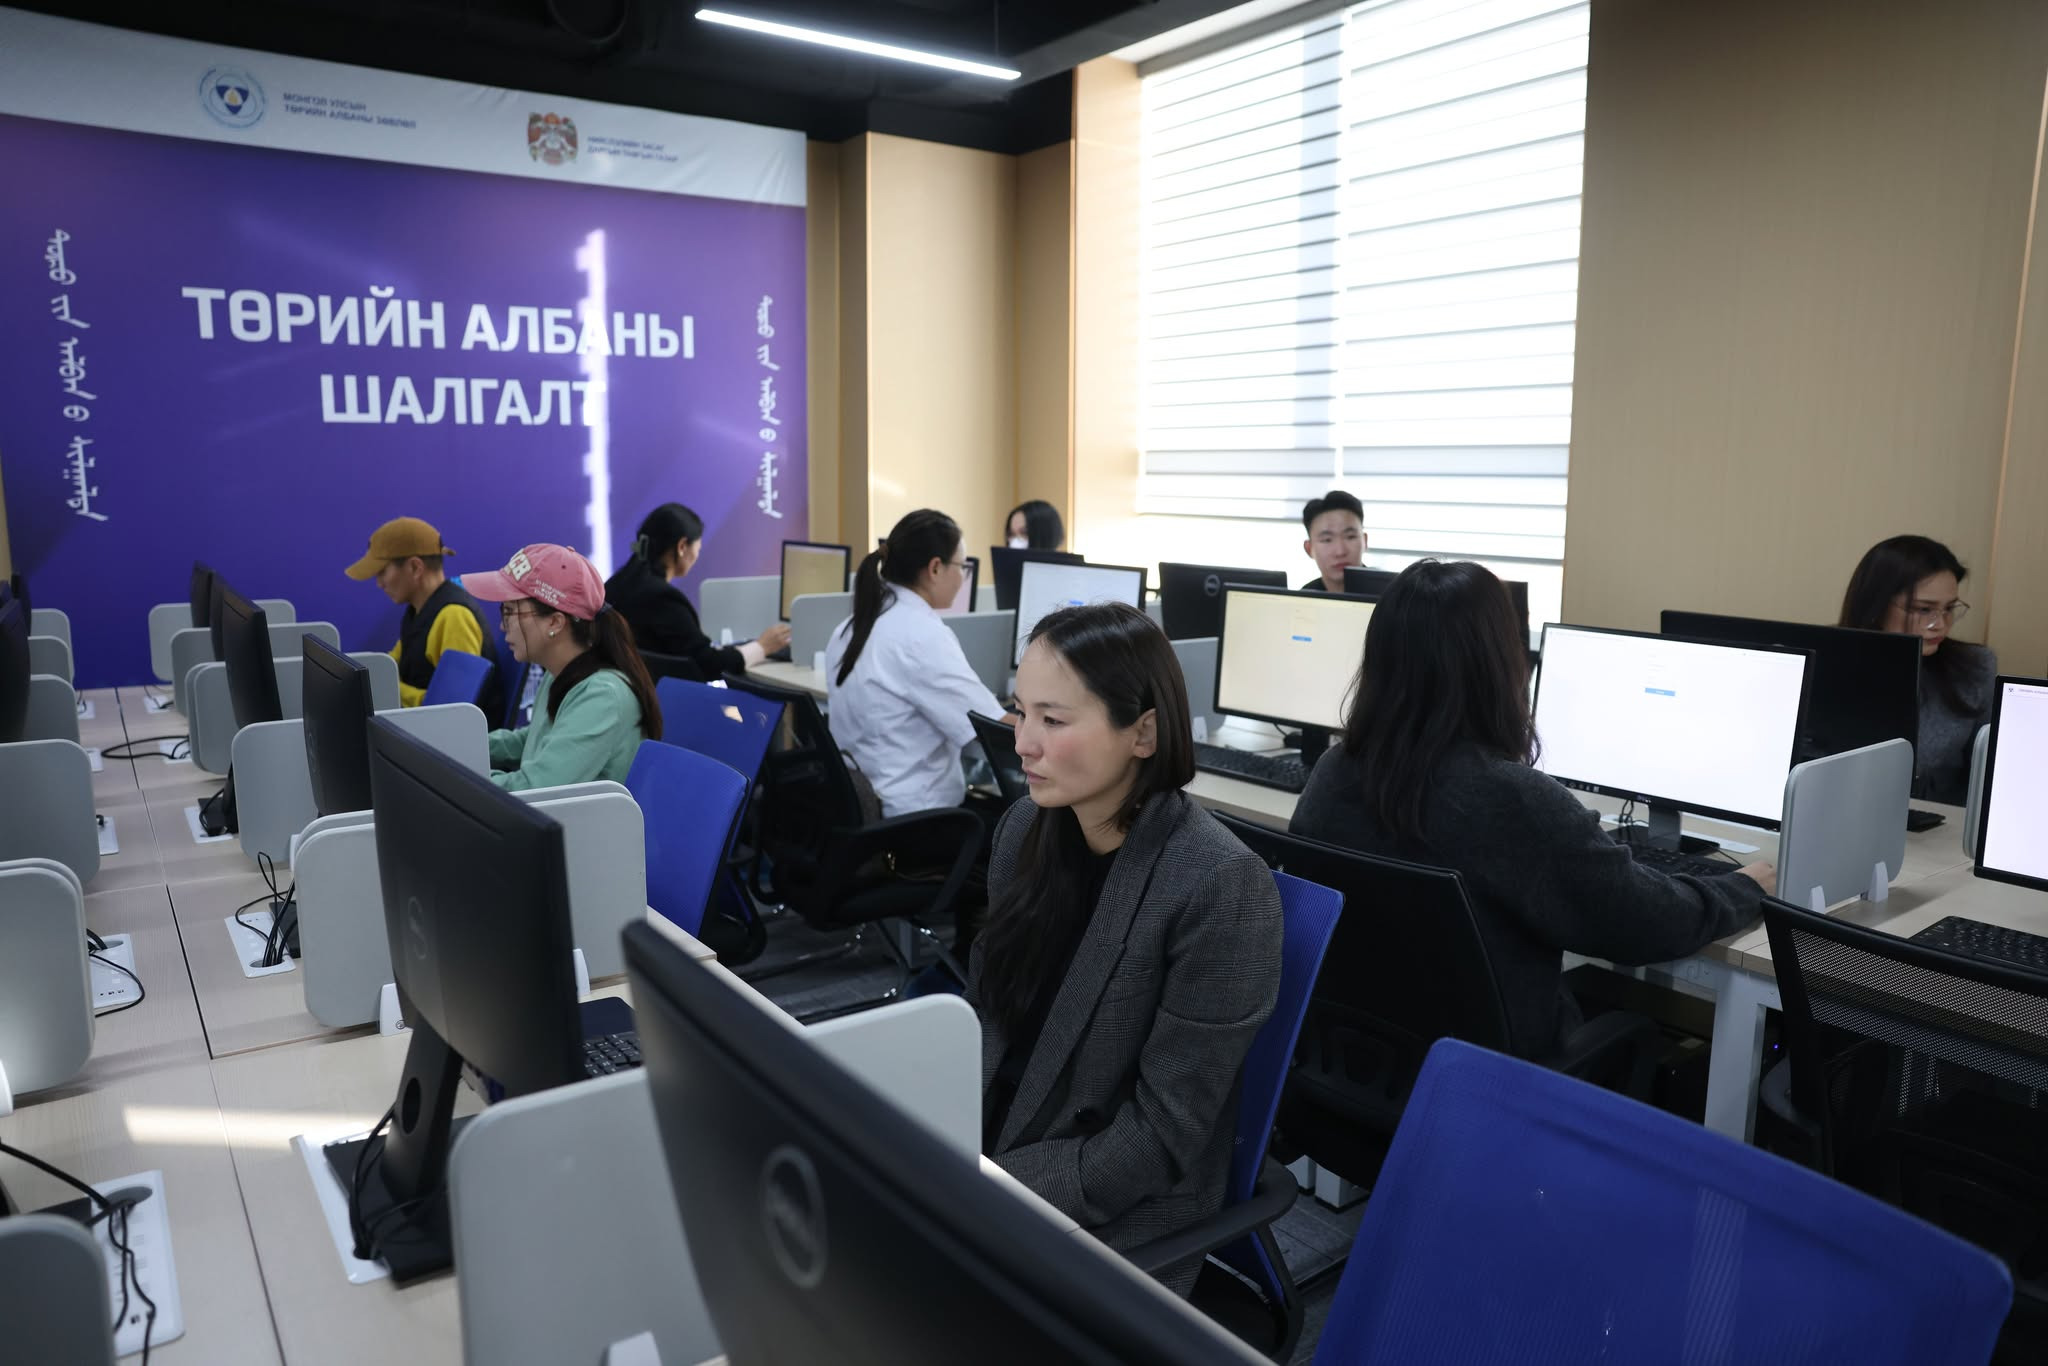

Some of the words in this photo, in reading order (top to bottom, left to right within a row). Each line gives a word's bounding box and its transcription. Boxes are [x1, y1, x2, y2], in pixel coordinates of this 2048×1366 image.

[182, 286, 446, 349] ТӨРИЙН
[461, 303, 695, 359] АЛБАНЫ
[320, 374, 606, 426] ШАЛГАЛТ
